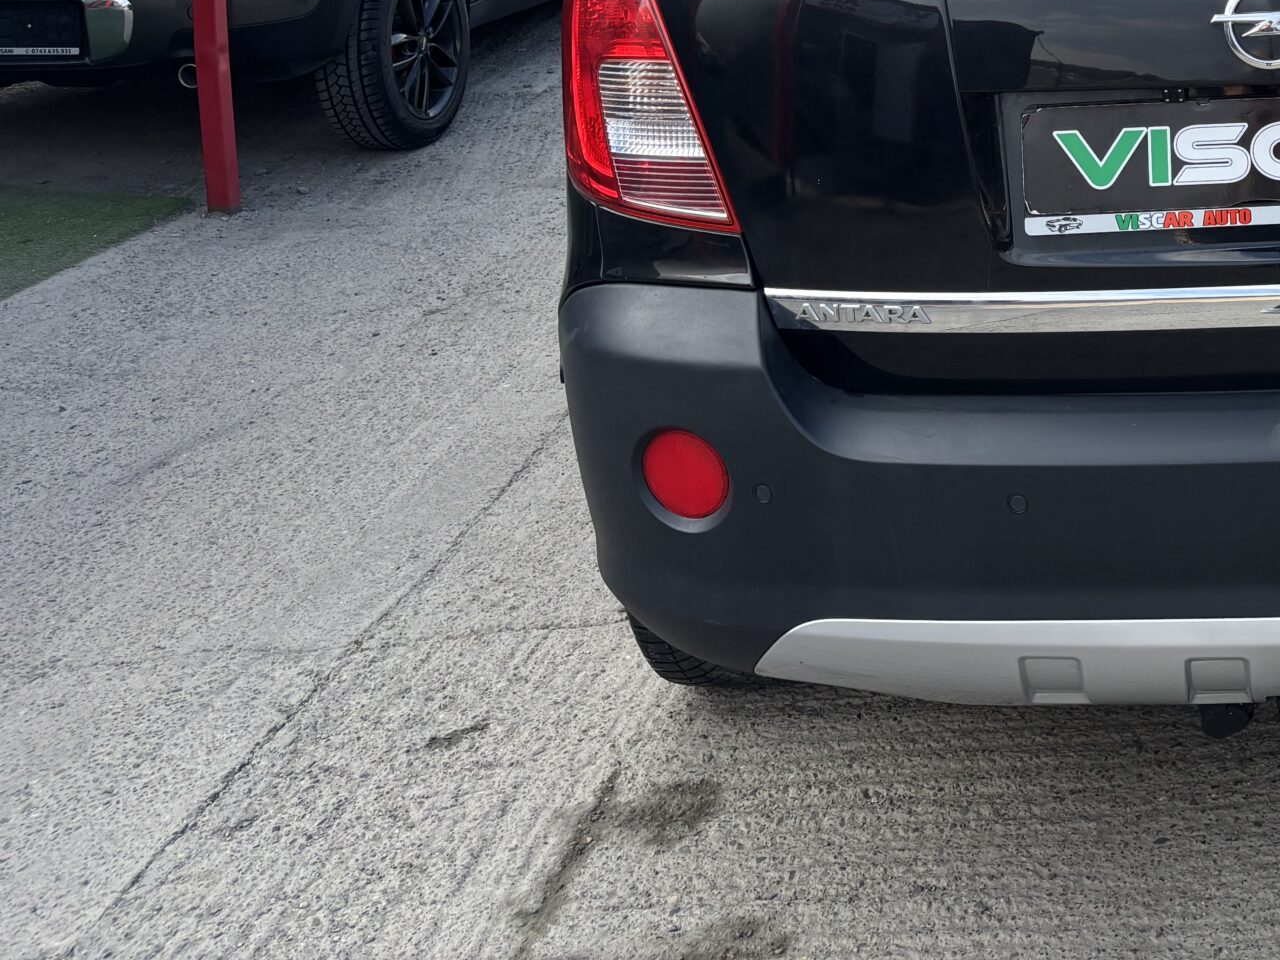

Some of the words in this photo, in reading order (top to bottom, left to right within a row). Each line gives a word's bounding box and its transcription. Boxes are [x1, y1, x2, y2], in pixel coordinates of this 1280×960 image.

[1114, 210, 1195, 231] VISCAR
[1203, 208, 1253, 226] AUTO
[795, 302, 933, 325] ANTARA
